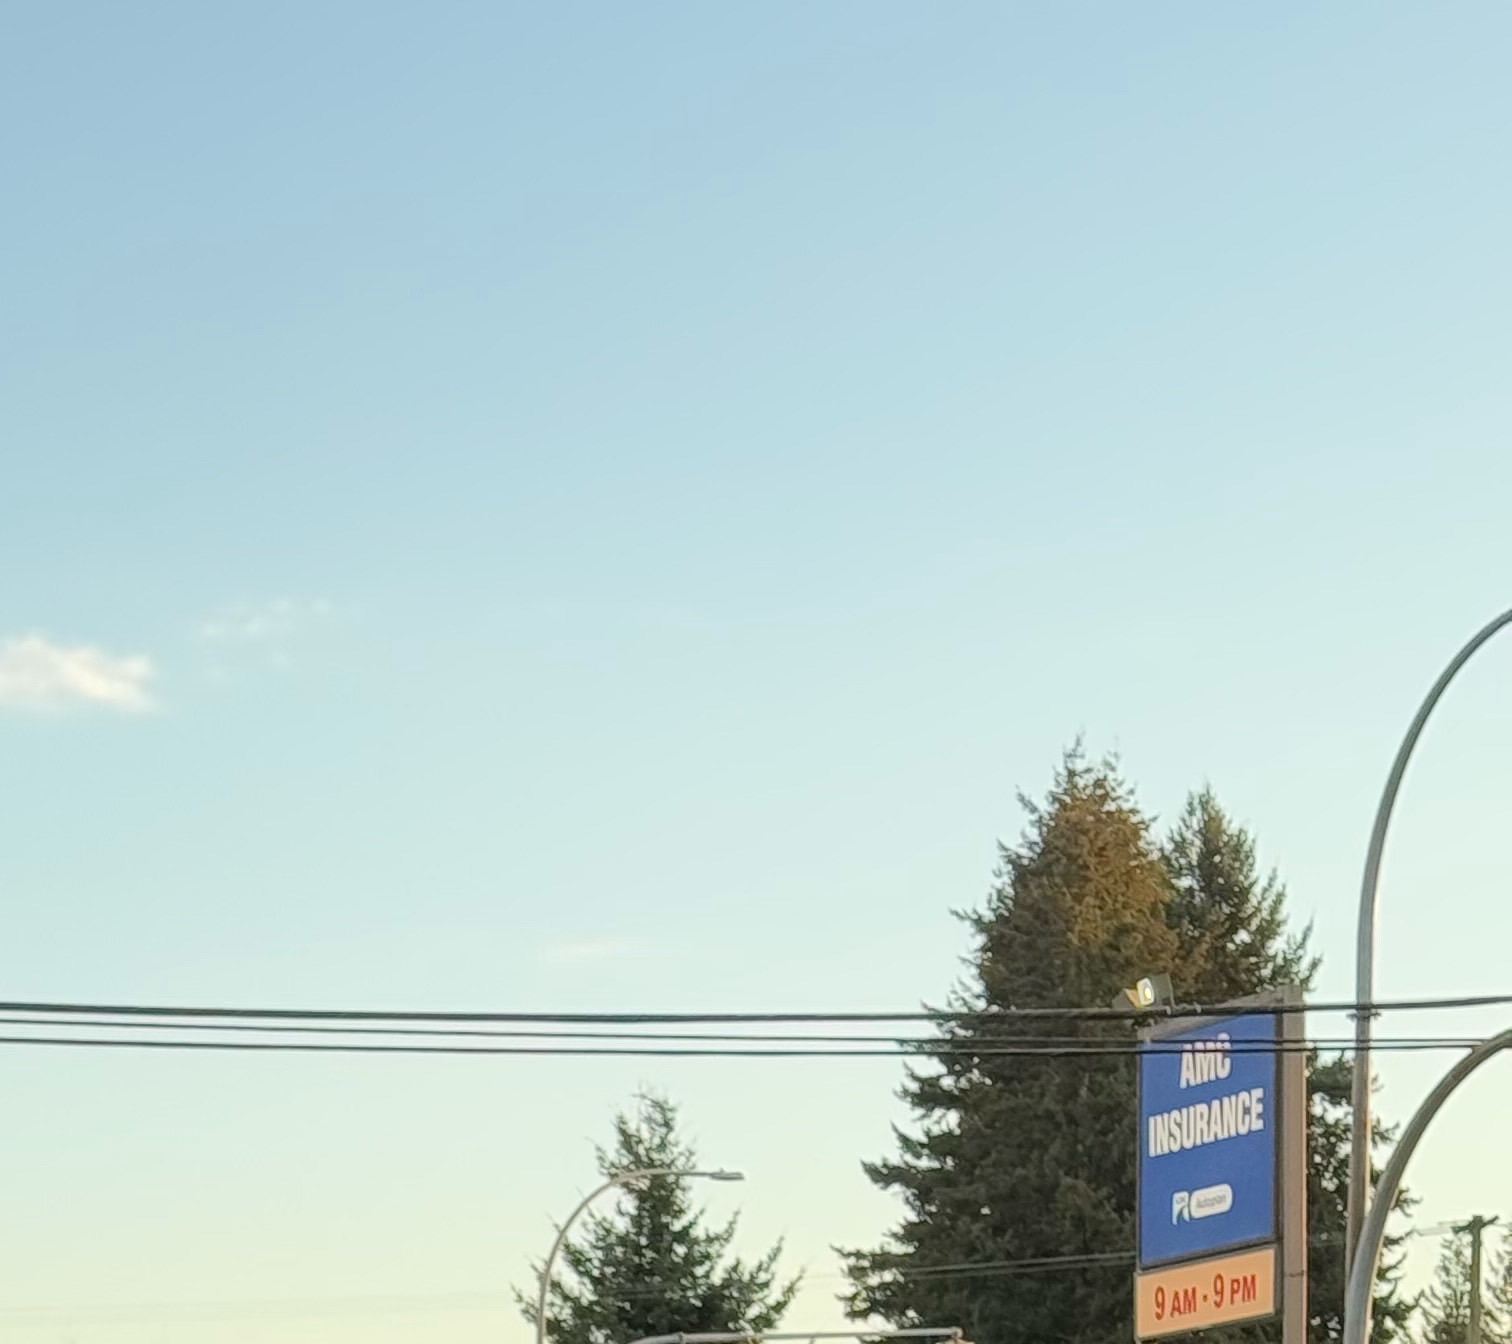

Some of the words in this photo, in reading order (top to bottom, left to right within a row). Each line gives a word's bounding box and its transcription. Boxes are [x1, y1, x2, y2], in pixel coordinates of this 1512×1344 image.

[1179, 1032, 1232, 1089] AMC
[1148, 1087, 1264, 1158] INSURANCE
[1155, 1285, 1165, 1321] 9
[1170, 1286, 1197, 1318] AM
[1213, 1273, 1225, 1309] 9
[1230, 1274, 1257, 1306] PM
